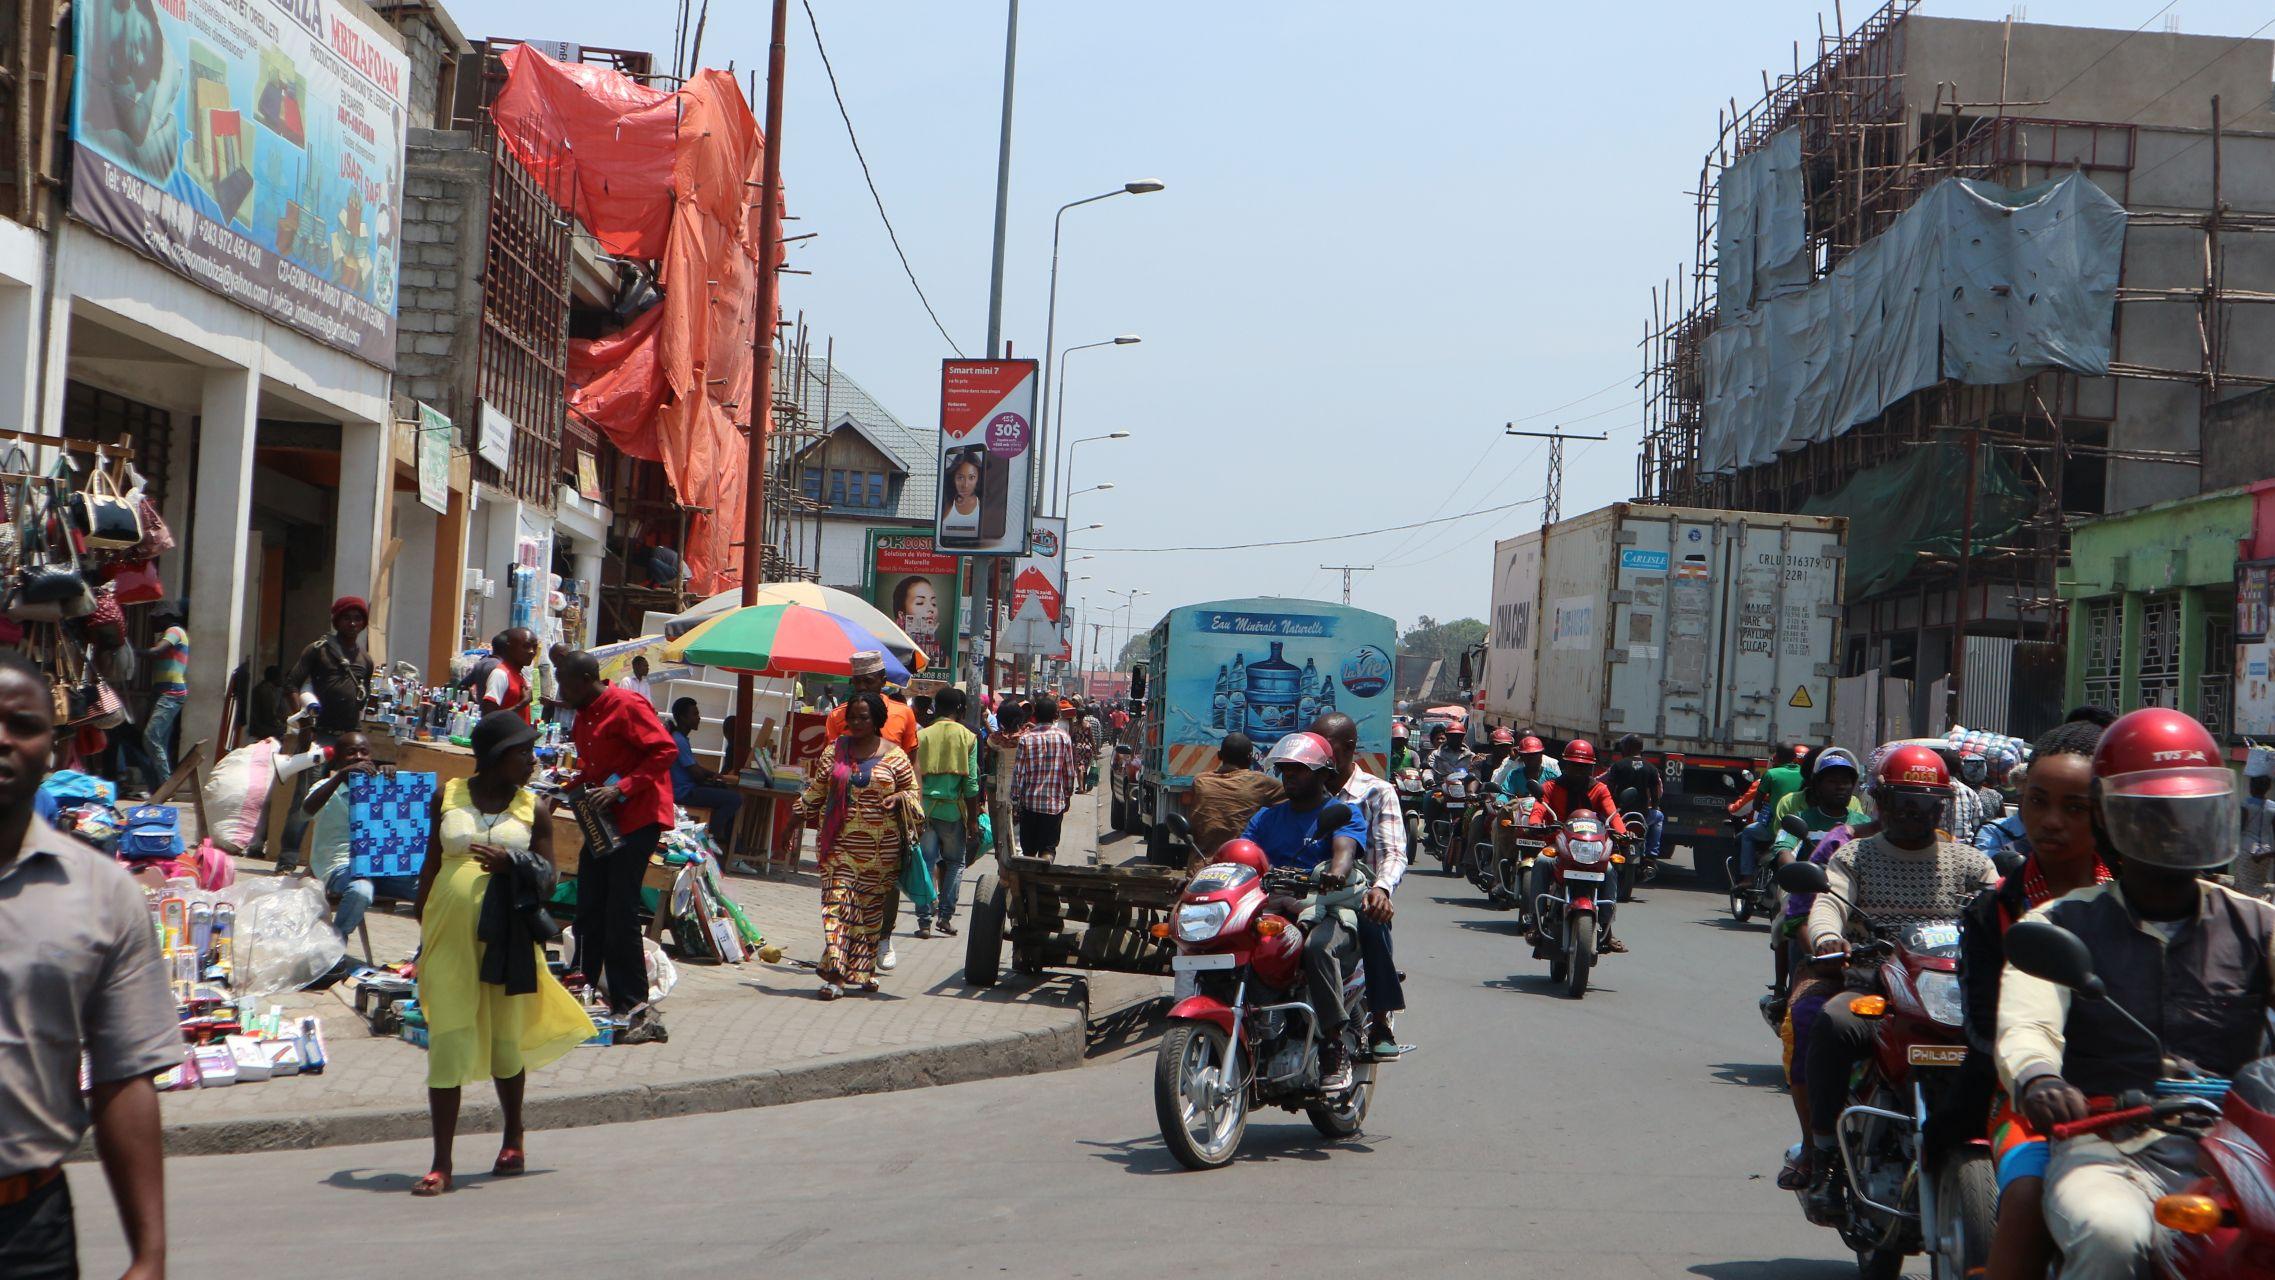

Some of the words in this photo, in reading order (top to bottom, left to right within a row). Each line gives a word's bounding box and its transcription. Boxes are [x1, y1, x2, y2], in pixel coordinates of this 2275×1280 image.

[330, 13, 399, 99] MBIZAFOAM
[104, 162, 120, 193] Tel:
[121, 175, 142, 206] +243
[199, 220, 217, 249] +243
[217, 230, 233, 255] 972
[247, 244, 261, 269] 420
[948, 366, 974, 375] Smart
[974, 366, 993, 375] mini
[994, 367, 1000, 375] 7
[995, 421, 1021, 439] 30$
[1623, 551, 1667, 565] CARLISLE
[1759, 553, 1782, 566] CRLU
[1786, 555, 1820, 568] 316379
[1785, 569, 1808, 583] 22R1
[1211, 615, 1232, 630] Eau
[1235, 617, 1277, 632] Minérale
[1281, 619, 1325, 634] Naturelle
[1496, 604, 1512, 649] CMA
[1511, 601, 1530, 650] CGM
[1743, 628, 1773, 640] PAYLOAD
[1665, 760, 1684, 777] 80
[577, 800, 606, 852] Hennessy
